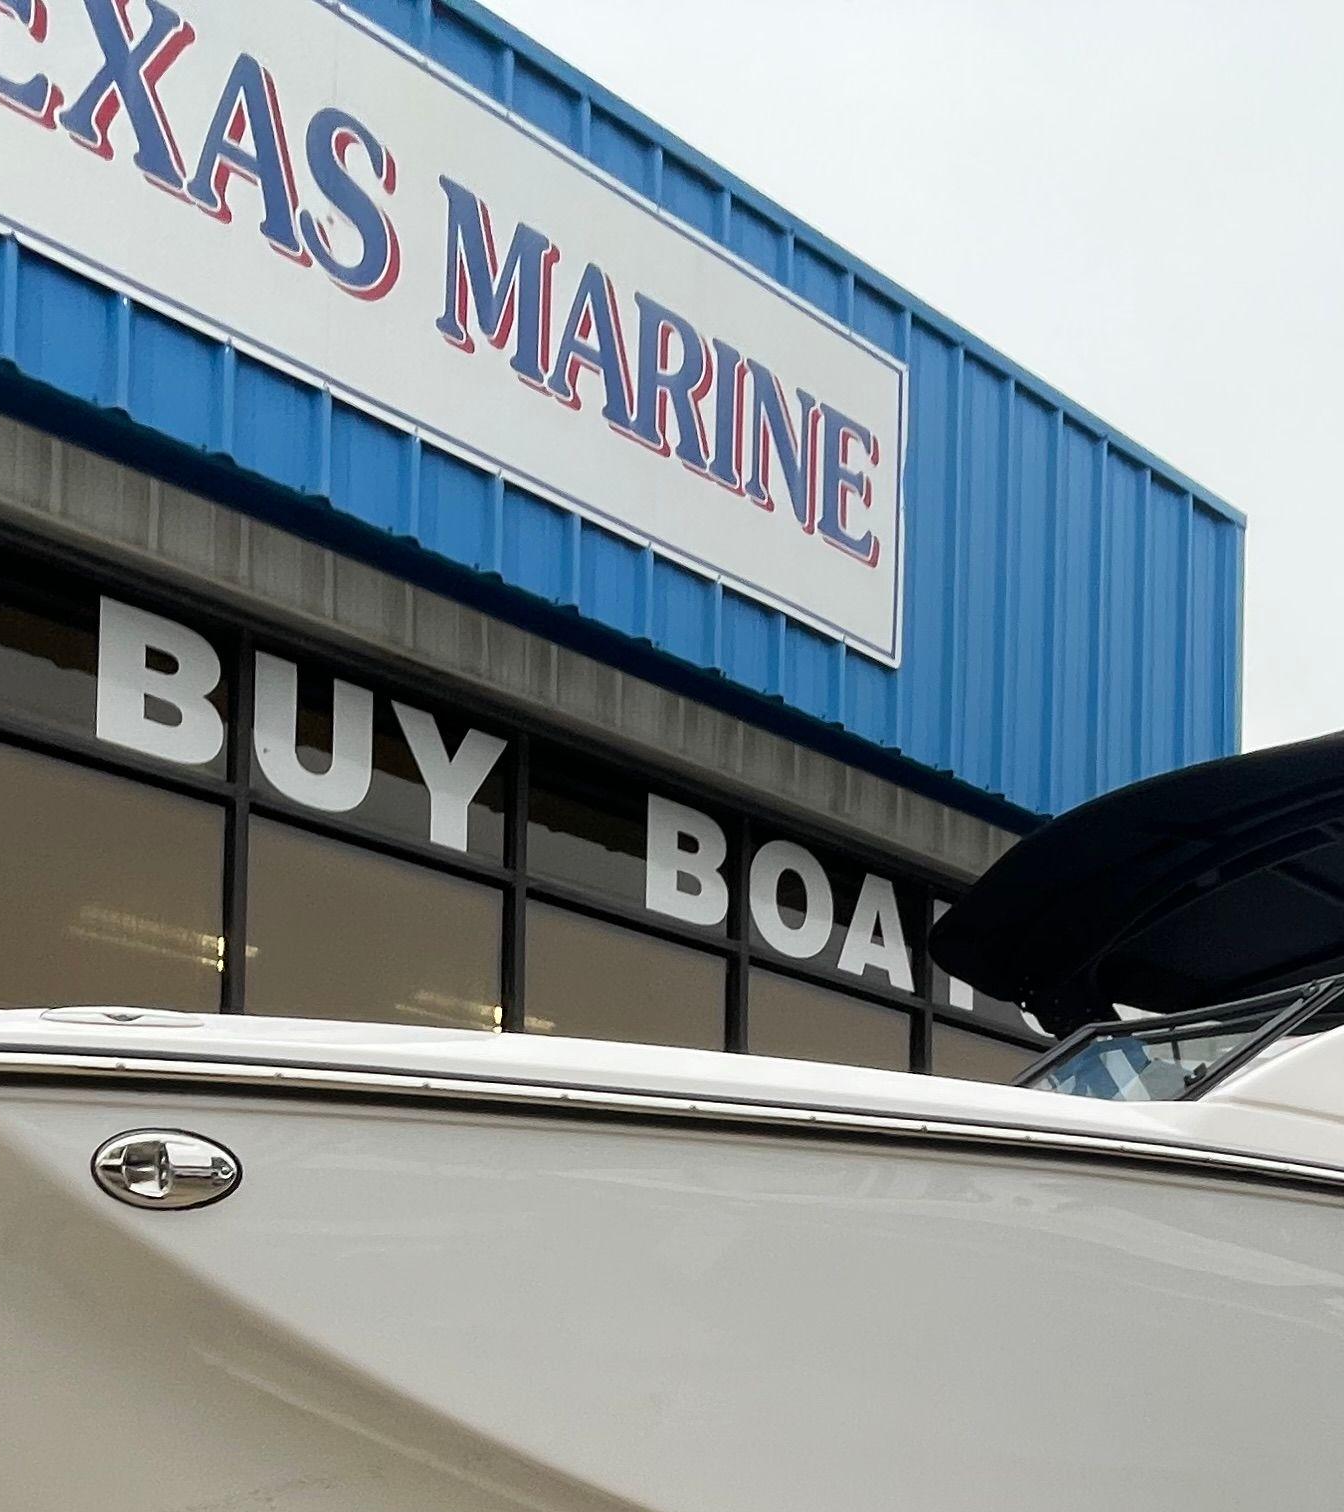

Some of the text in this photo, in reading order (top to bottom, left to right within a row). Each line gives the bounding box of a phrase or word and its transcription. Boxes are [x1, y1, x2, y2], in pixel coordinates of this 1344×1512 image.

[434, 173, 881, 570] MARINE
[96, 595, 508, 852] BUY
[645, 793, 1056, 1038] BOA
